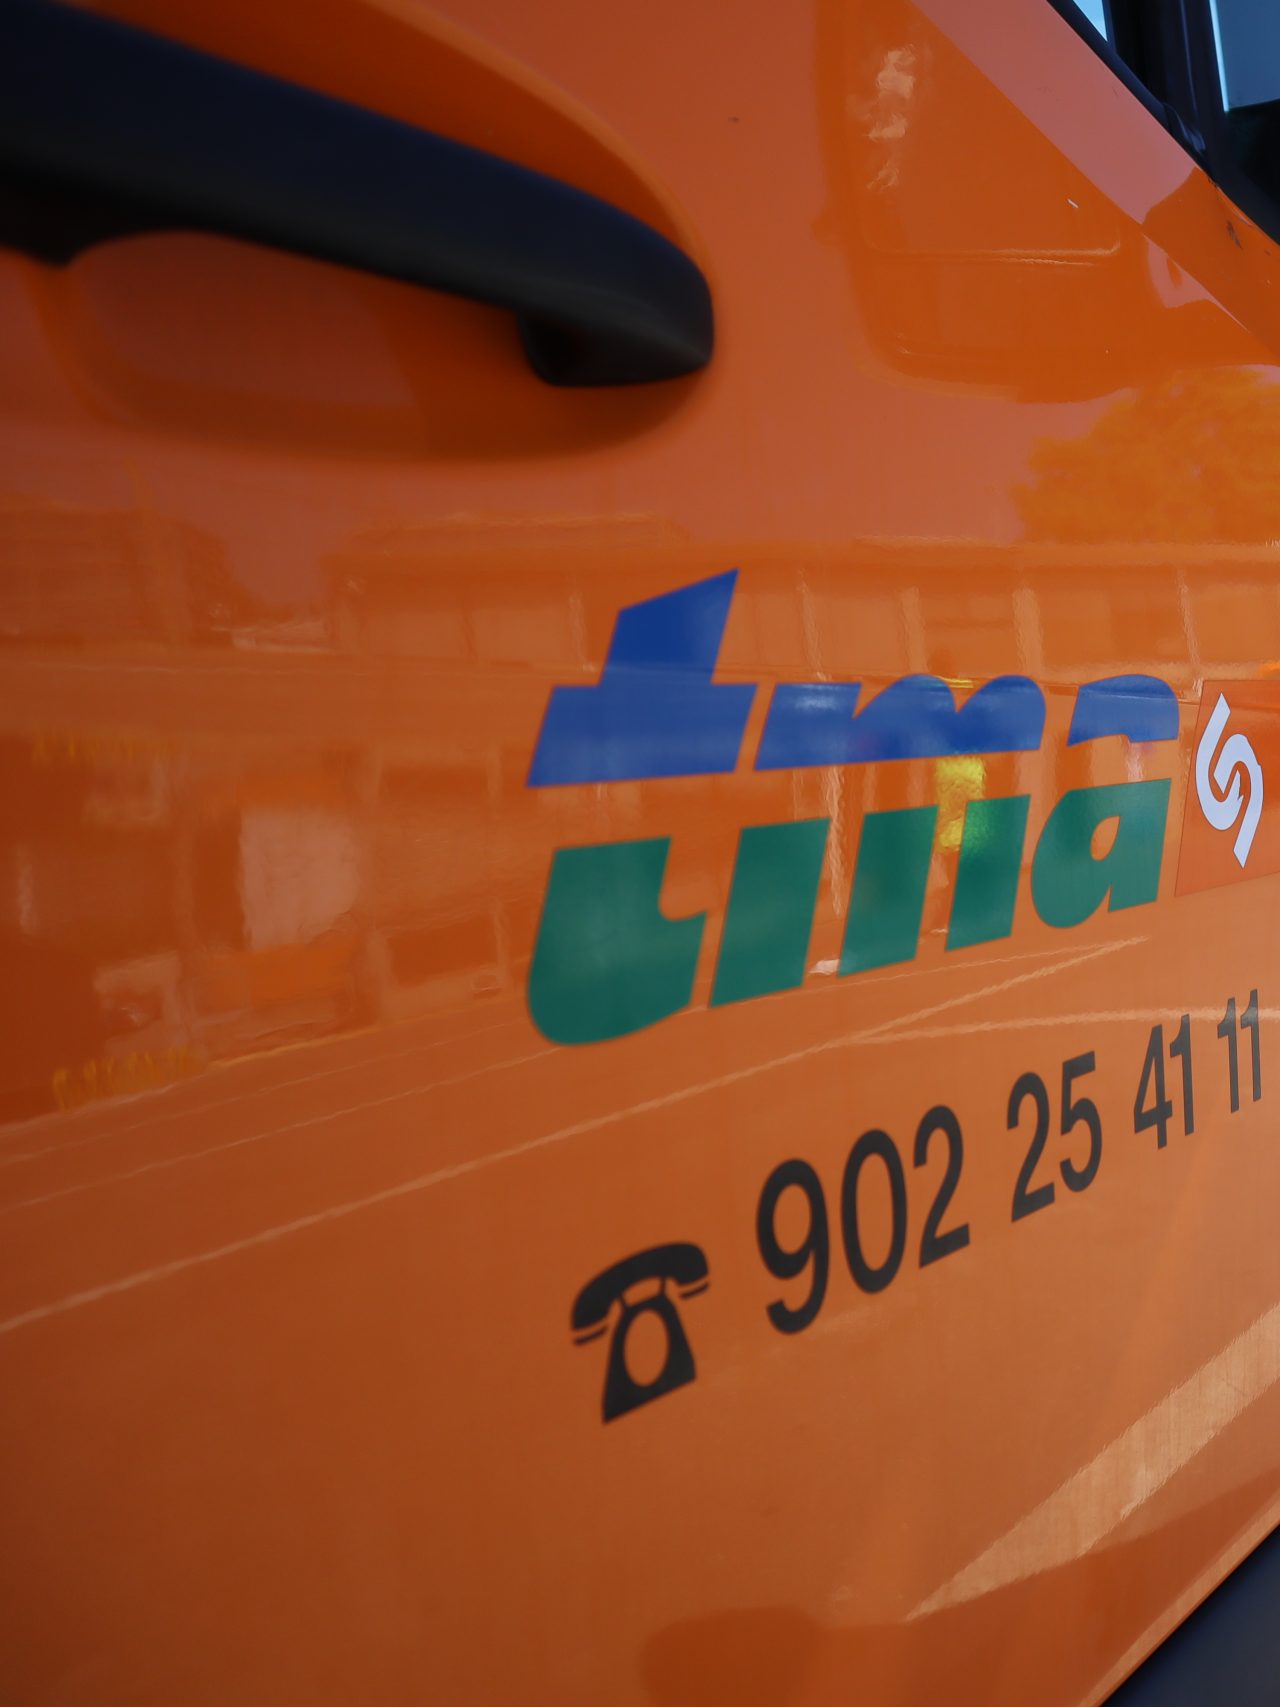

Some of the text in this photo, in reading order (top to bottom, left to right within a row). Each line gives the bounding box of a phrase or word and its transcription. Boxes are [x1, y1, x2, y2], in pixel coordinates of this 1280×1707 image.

[756, 988, 1262, 1335] 902 25 41 11
